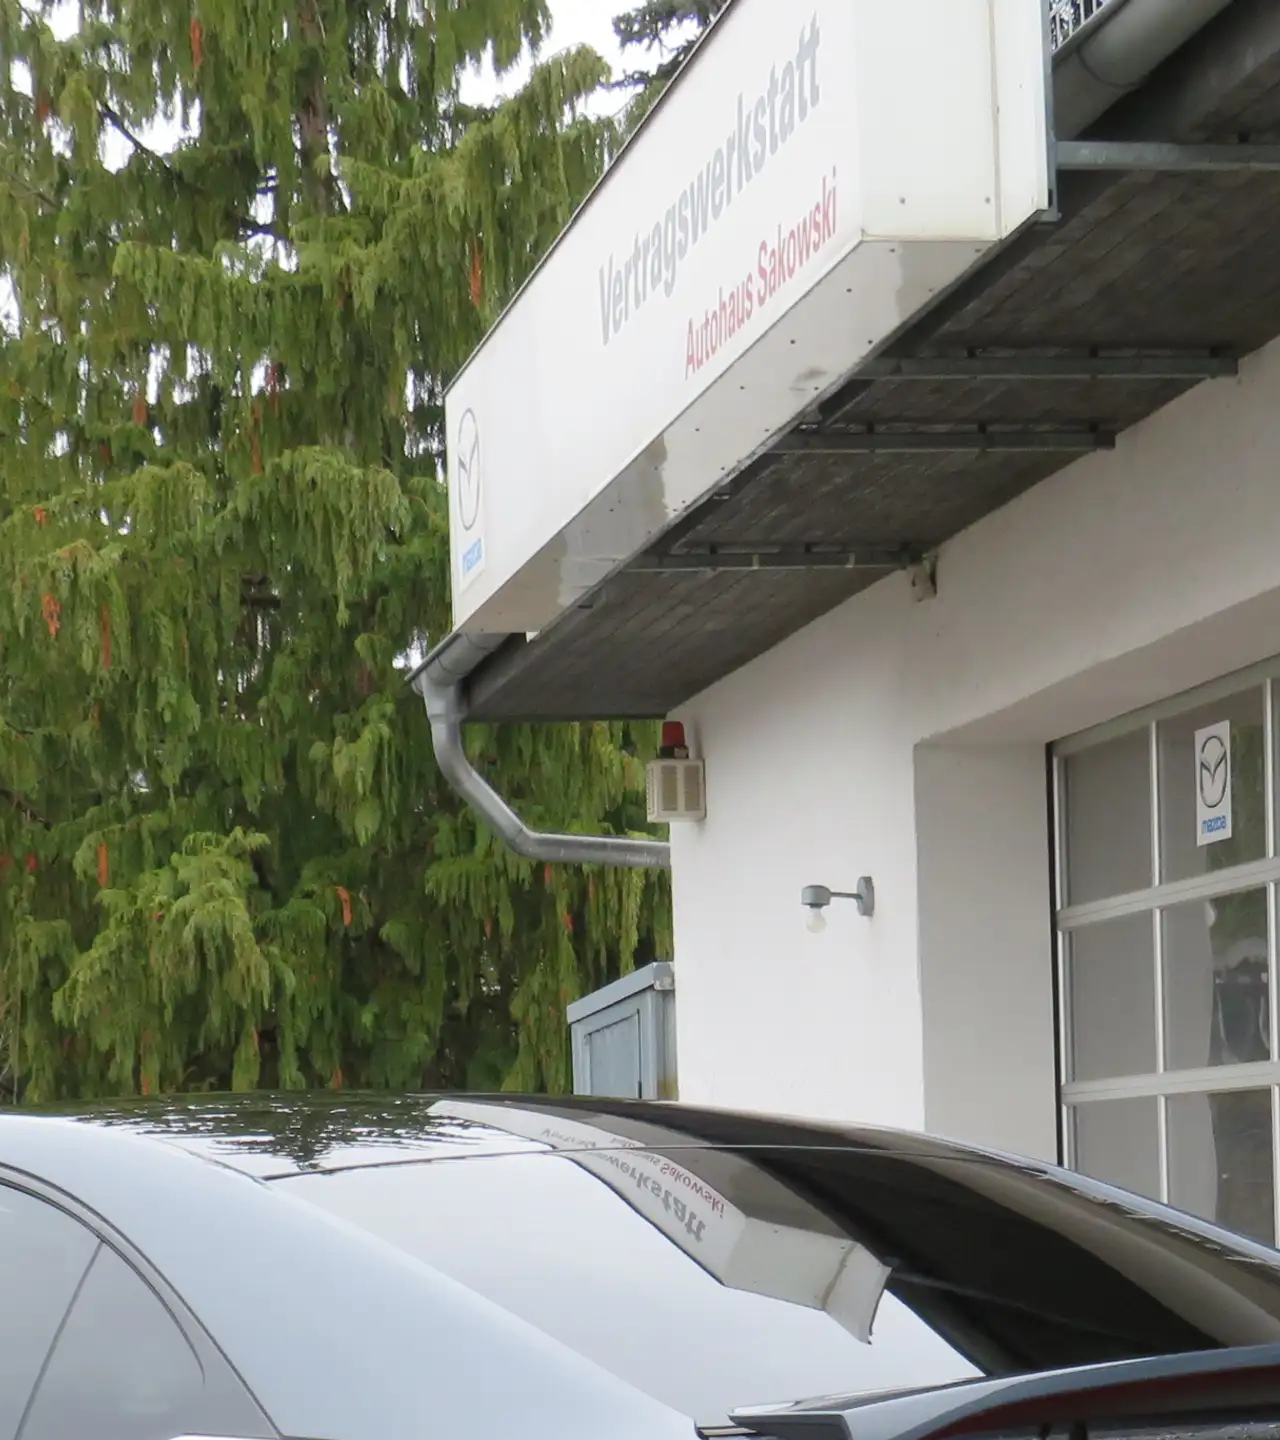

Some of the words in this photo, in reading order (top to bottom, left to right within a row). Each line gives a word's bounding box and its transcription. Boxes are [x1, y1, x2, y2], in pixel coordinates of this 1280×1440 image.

[598, 12, 821, 346] Vertragswerkstatt
[684, 271, 754, 381] Autohaus
[756, 165, 838, 308] Sakowski
